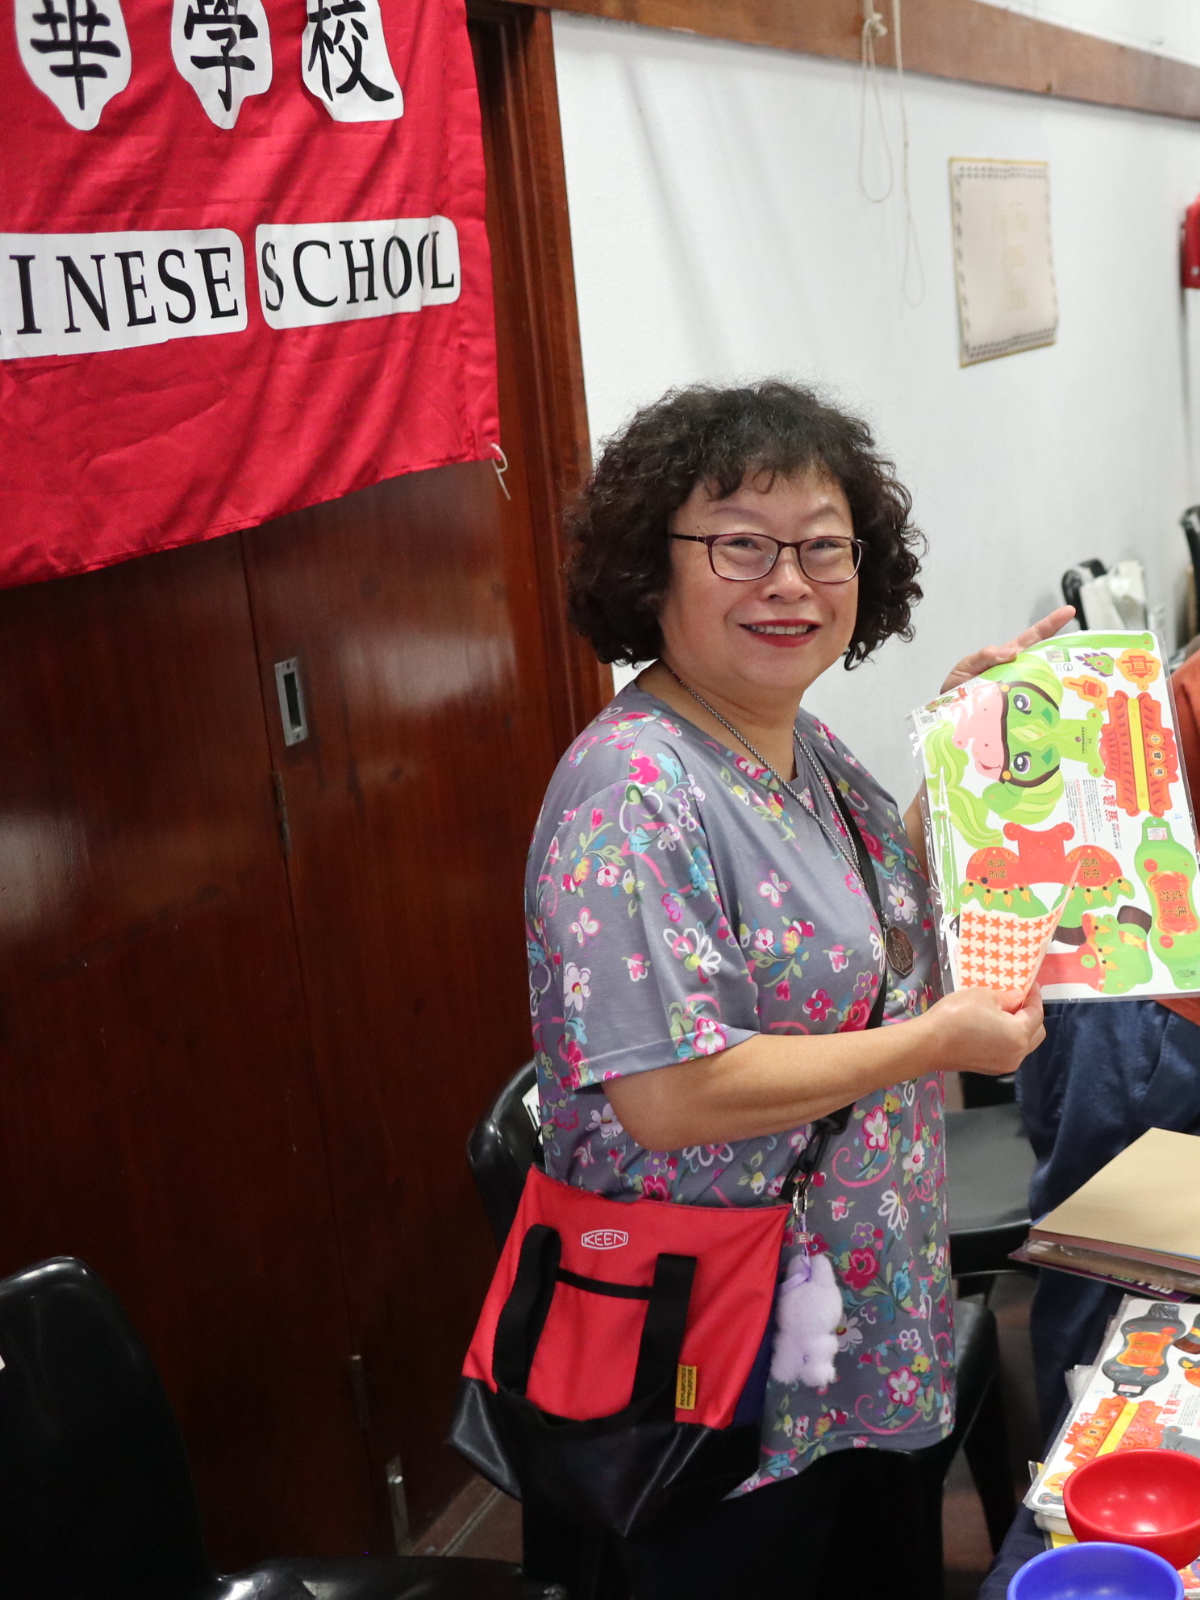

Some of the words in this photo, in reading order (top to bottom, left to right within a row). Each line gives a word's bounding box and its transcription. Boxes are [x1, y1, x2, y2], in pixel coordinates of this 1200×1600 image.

[0, 247, 240, 335] INESE
[260, 230, 456, 313] SCHOOL
[583, 1231, 627, 1247] KEEN
